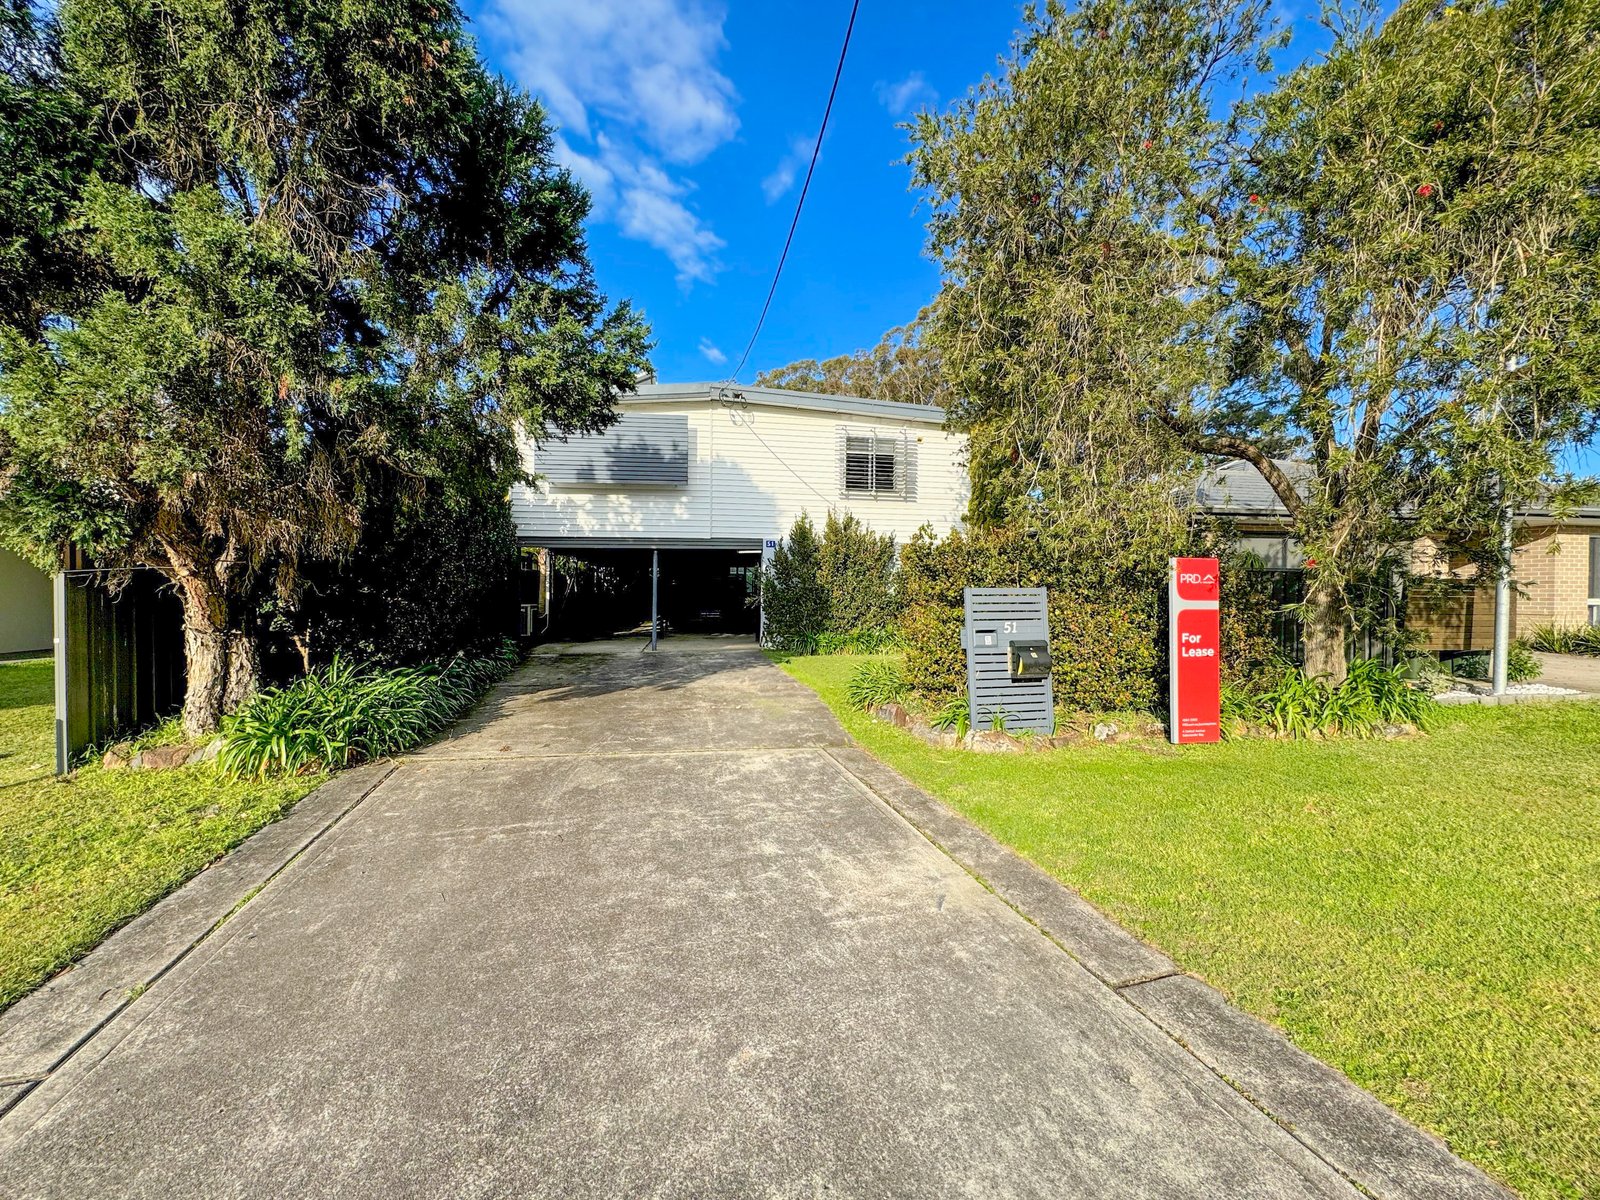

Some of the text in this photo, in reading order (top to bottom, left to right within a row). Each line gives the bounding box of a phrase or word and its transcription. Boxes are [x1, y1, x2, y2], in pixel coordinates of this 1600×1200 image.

[1003, 621, 1017, 633] 51
[1181, 632, 1201, 643] For
[1181, 646, 1214, 657] Lease
